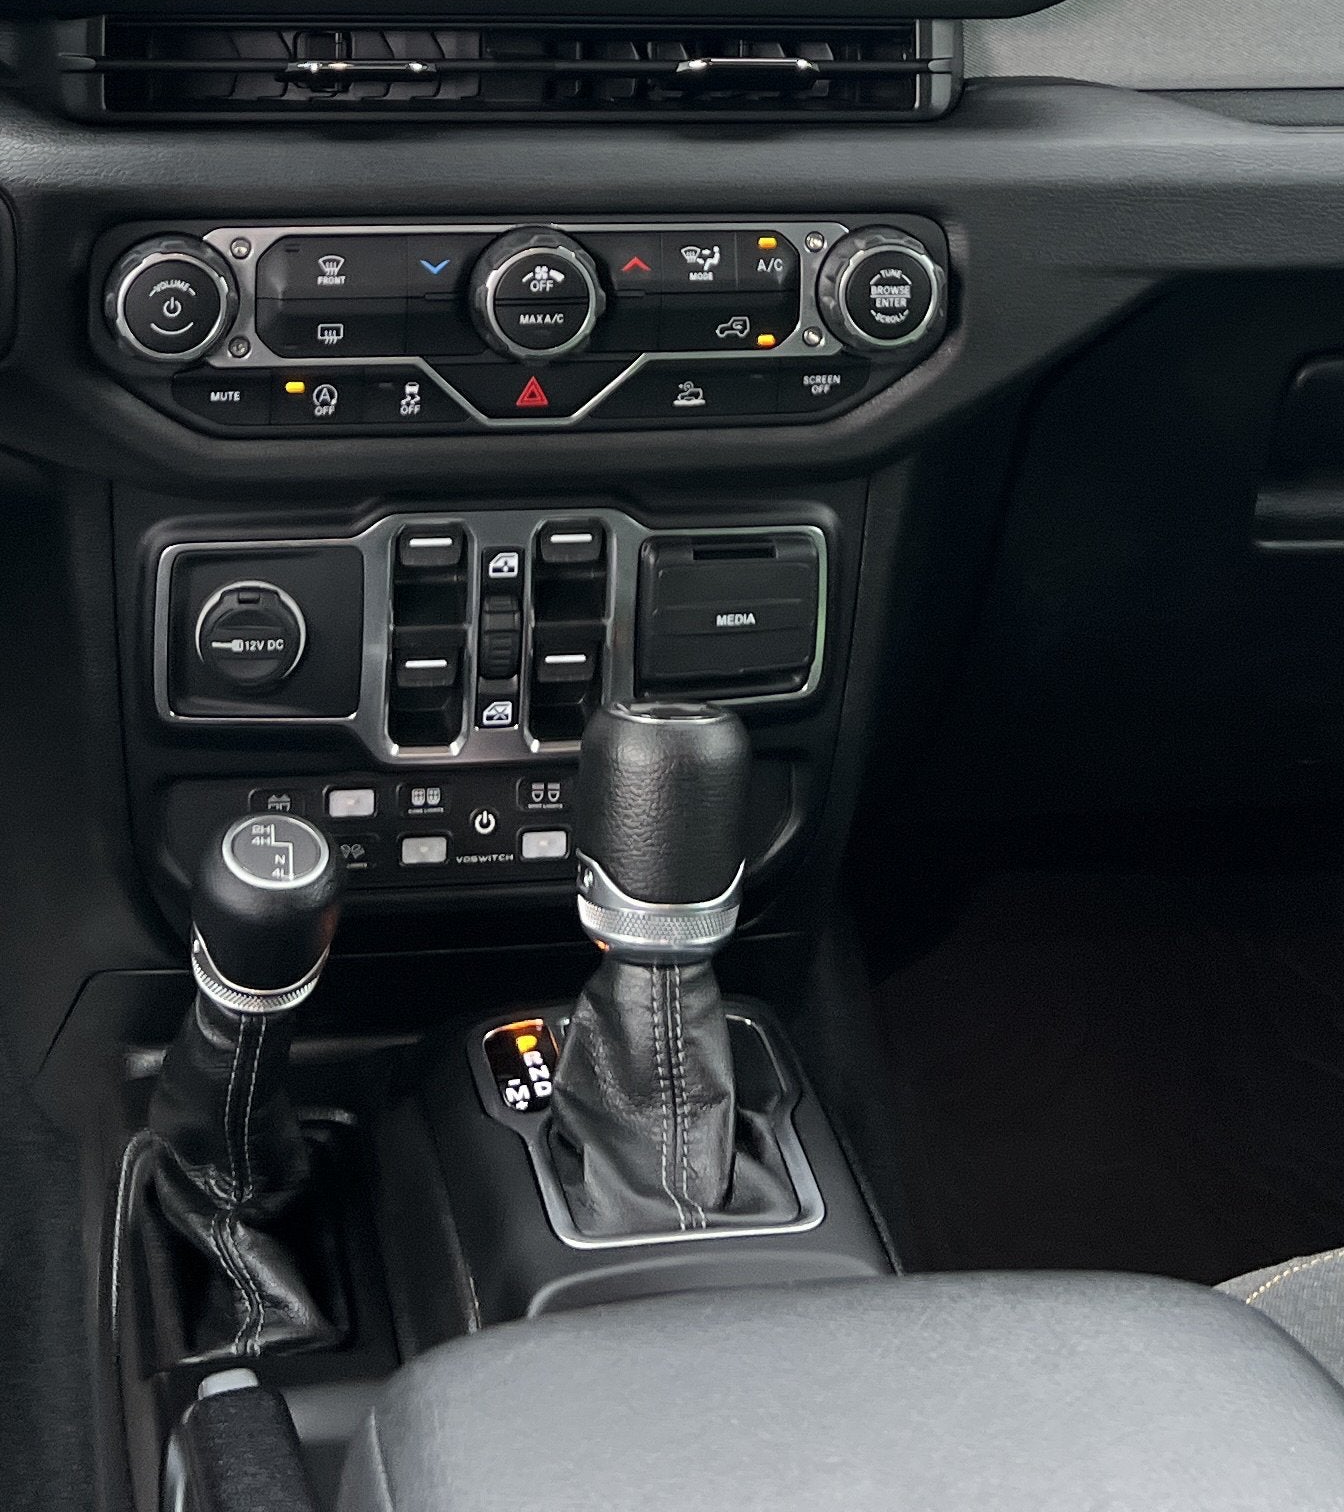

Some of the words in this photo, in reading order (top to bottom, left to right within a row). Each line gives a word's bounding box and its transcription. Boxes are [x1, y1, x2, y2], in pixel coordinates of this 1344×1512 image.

[756, 257, 784, 274] A/C
[688, 271, 715, 282] MODE
[880, 268, 903, 280] TUNE
[151, 279, 192, 293] VOLUME
[316, 275, 347, 287] FRONT
[528, 278, 555, 293] OFF
[870, 284, 911, 297] BROWSE
[875, 297, 908, 309] ENTER
[518, 313, 543, 326] MAX
[543, 313, 565, 326] A/C
[871, 309, 909, 325] SCROLL
[802, 374, 842, 387] SCREEN
[810, 383, 832, 395] OFF
[209, 390, 242, 403] MUTE
[314, 404, 336, 417] OFF
[399, 403, 422, 416] OFF
[715, 611, 757, 627] MEDIA
[243, 638, 265, 652] 12V
[265, 637, 285, 652] DC
[251, 824, 271, 836] 2H
[251, 836, 272, 846] 4H
[274, 854, 286, 865] N
[271, 867, 290, 879] 4L
[522, 1050, 545, 1067] R
[528, 1064, 551, 1083] N
[505, 1084, 531, 1103] M
[533, 1080, 553, 1098] D
